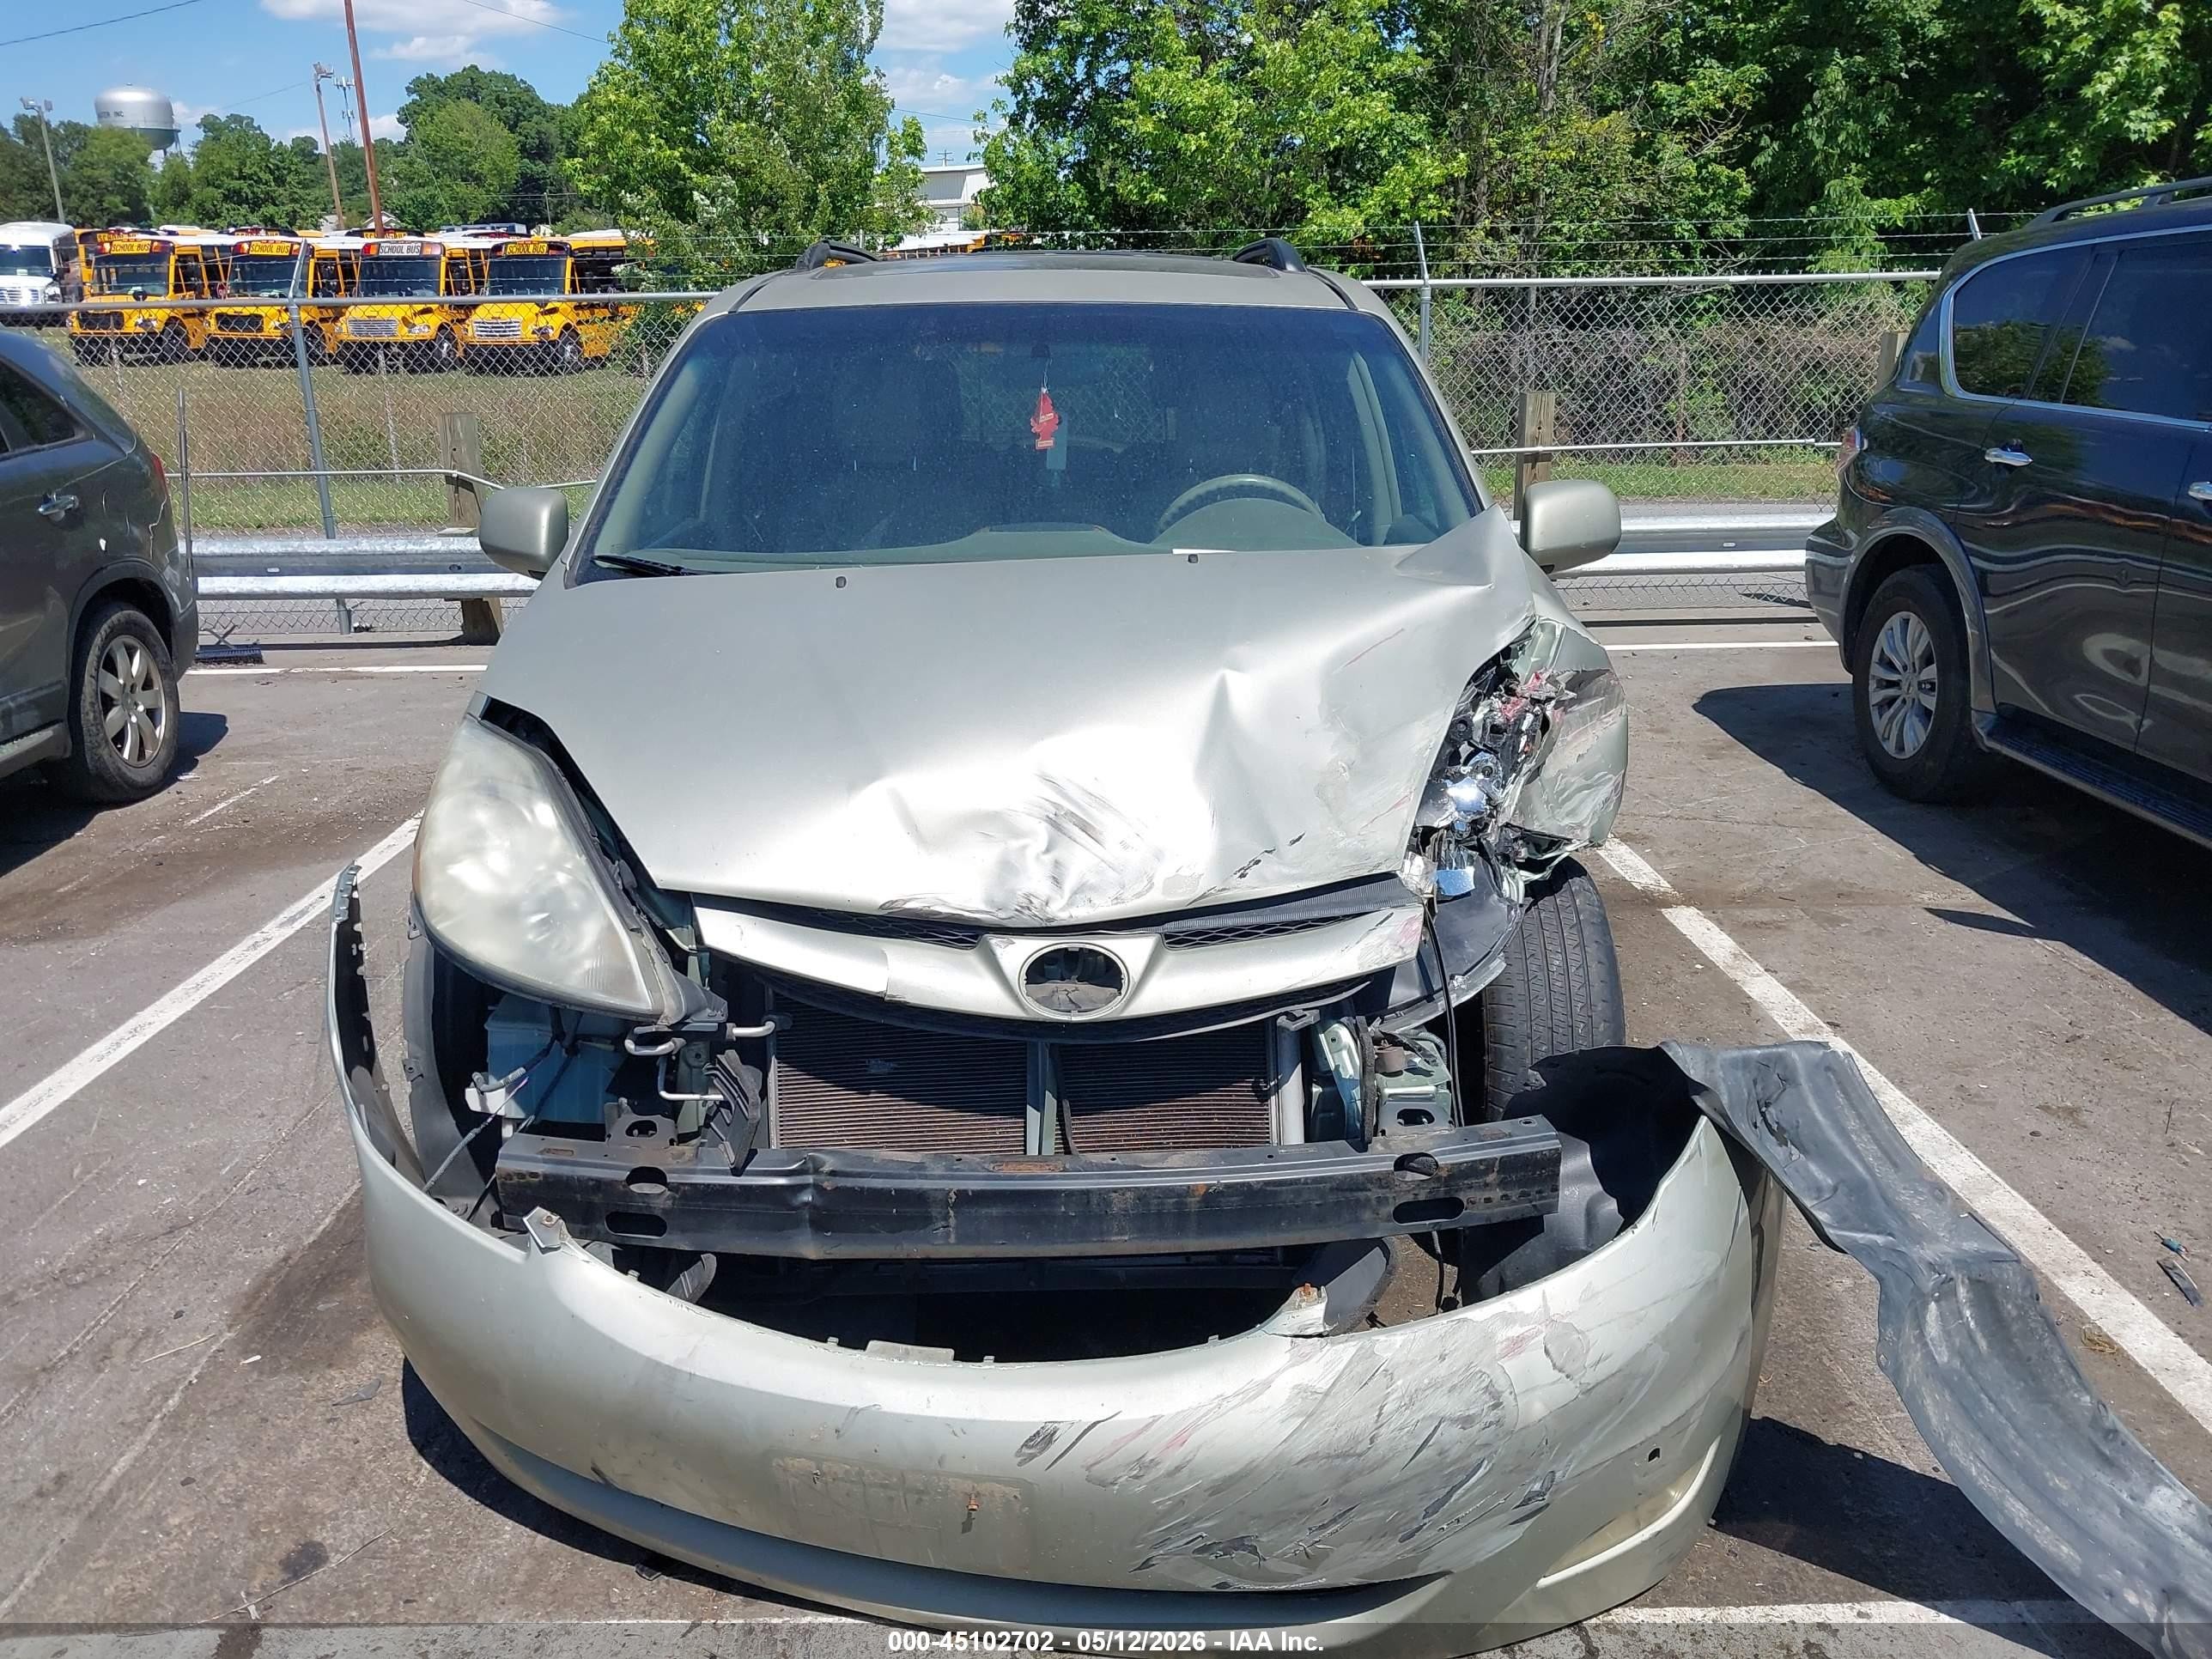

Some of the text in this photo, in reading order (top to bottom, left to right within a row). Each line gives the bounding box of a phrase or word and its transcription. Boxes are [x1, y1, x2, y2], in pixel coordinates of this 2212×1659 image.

[111, 242, 150, 252] SCHOOL BUS
[250, 244, 290, 253] SCHOOL BUS
[380, 245, 421, 254] SCHOOL BUS
[507, 244, 546, 254] SCHOOL BUS
